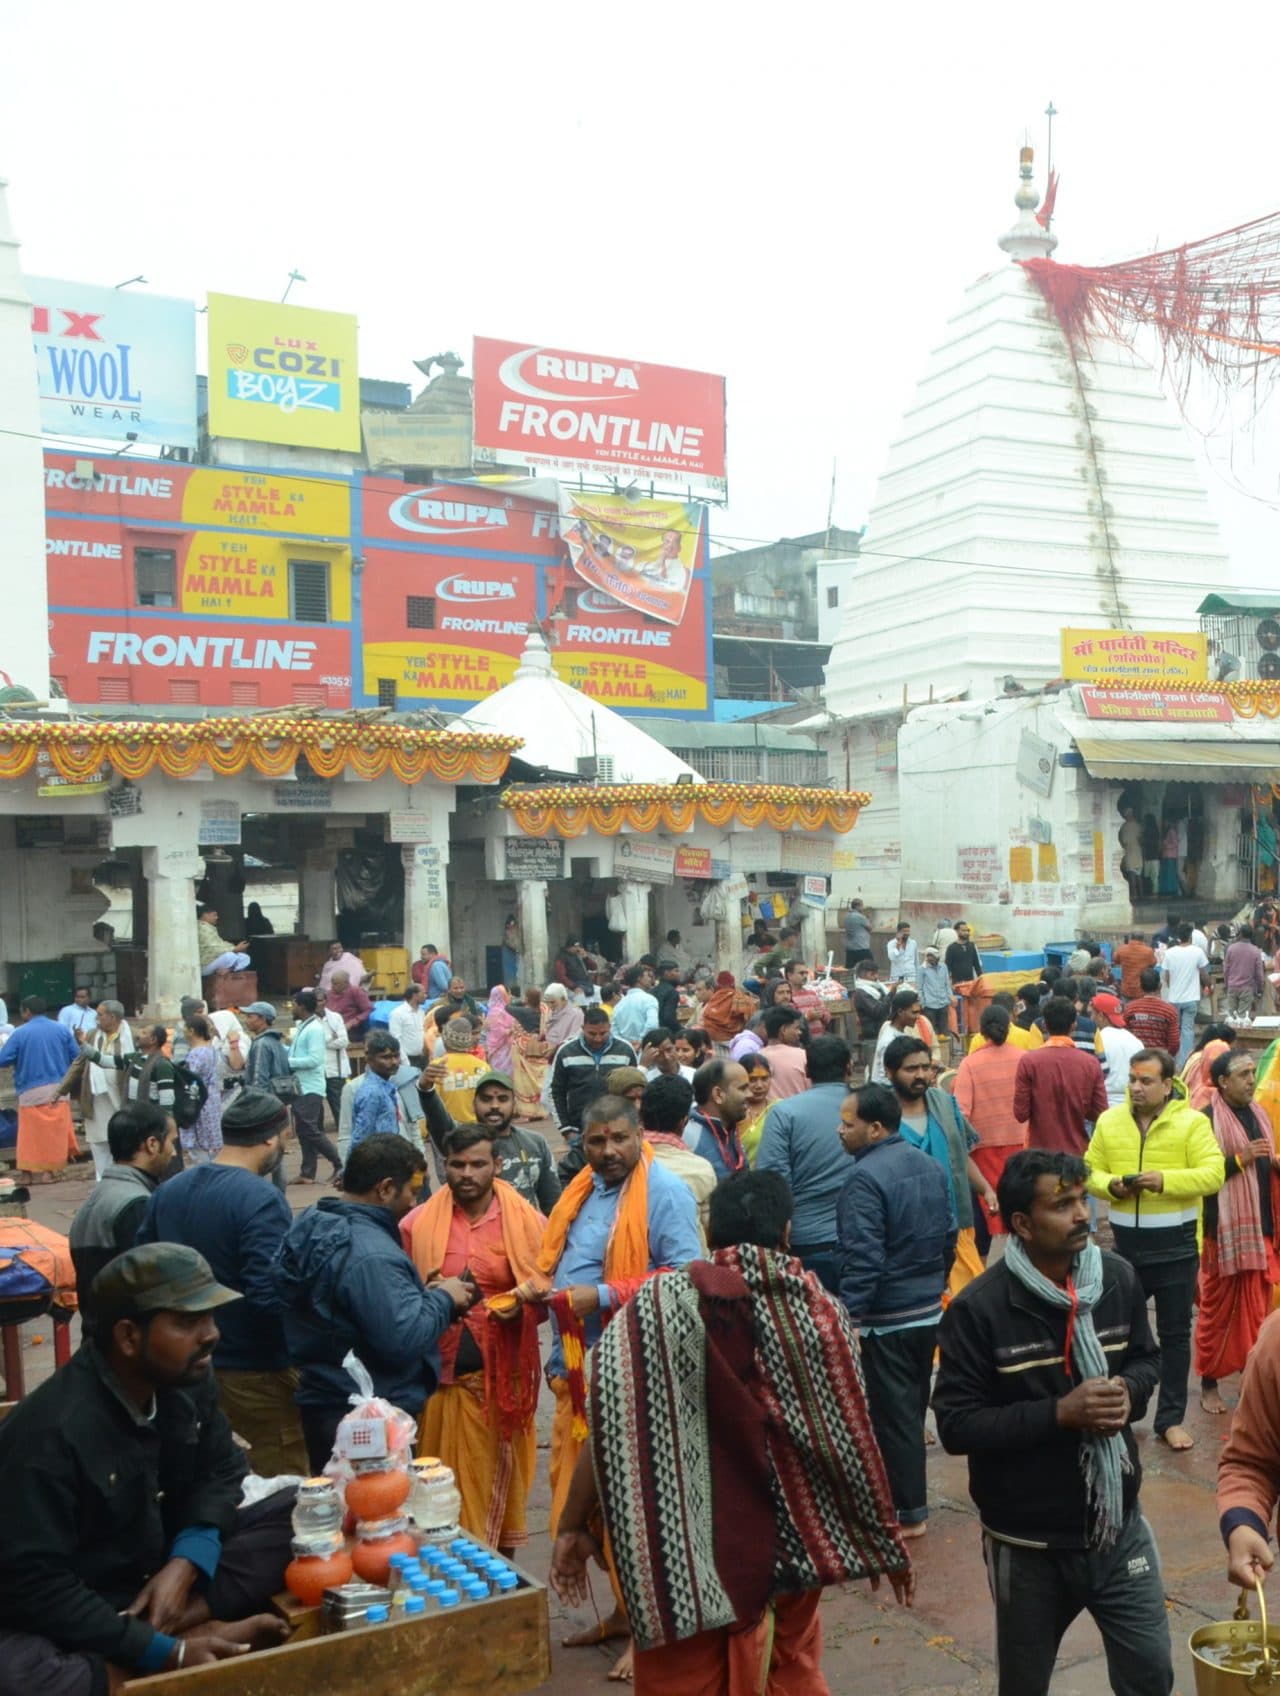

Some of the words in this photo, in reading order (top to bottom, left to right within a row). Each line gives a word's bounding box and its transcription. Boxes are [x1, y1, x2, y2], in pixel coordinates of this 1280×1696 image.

[274, 335, 318, 351] LUX
[253, 348, 341, 377] COZI
[536, 354, 640, 390] RUPA
[71, 404, 142, 422] WEAR
[498, 400, 705, 457] FRONTLINE
[610, 450, 640, 463] STYLE
[652, 456, 688, 469] MAMLA
[222, 485, 281, 501] STYLE
[213, 498, 297, 517] MAMLA
[418, 500, 508, 526] RUPA
[221, 541, 248, 553] YEH
[199, 554, 257, 575] STYLE
[261, 564, 277, 577] KA
[186, 574, 275, 598] MAMLA
[453, 579, 516, 599] RUPA
[441, 616, 530, 636] FRONTLINE
[566, 624, 672, 647] FRONTLINE
[87, 631, 318, 670] FRONTLINE
[1098, 634, 1148, 652] पार्वती
[427, 652, 490, 673] STYLE
[589, 661, 647, 679] STYLE
[416, 672, 500, 692] MAMLA
[583, 679, 655, 698] MAMLA
